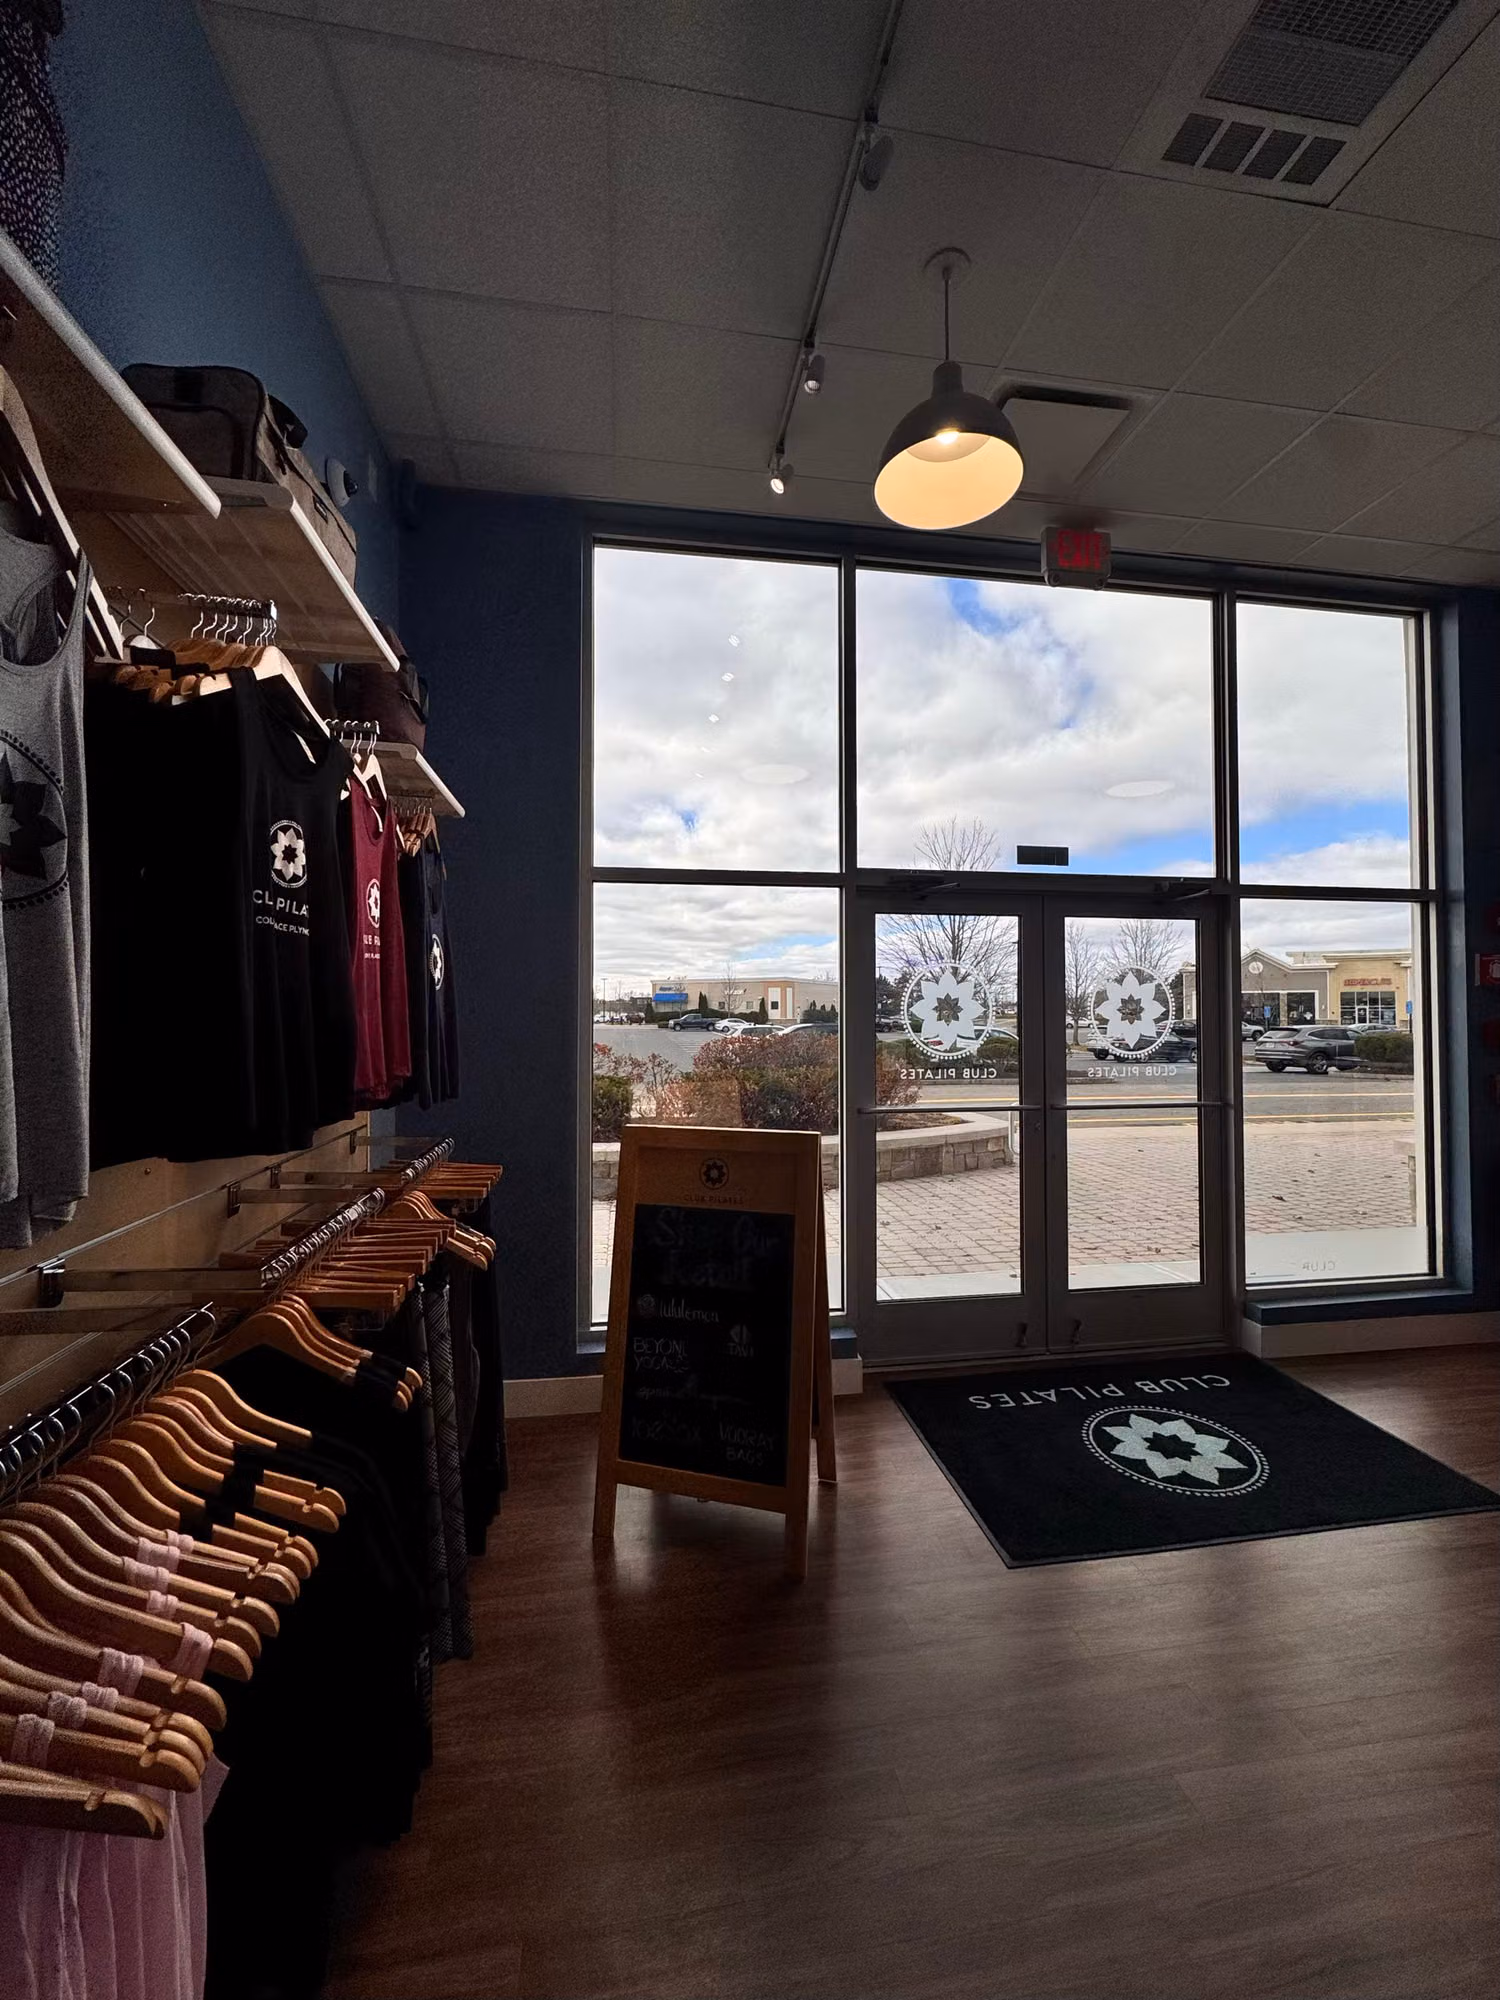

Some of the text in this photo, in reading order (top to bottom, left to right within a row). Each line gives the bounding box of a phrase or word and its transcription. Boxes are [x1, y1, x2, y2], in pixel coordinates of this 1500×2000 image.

[1057, 529, 1102, 569] EXIT
[276, 897, 311, 919] PILA
[968, 1374, 1231, 1410] CLUB PILATES
[725, 1446, 765, 1467] BAGS
